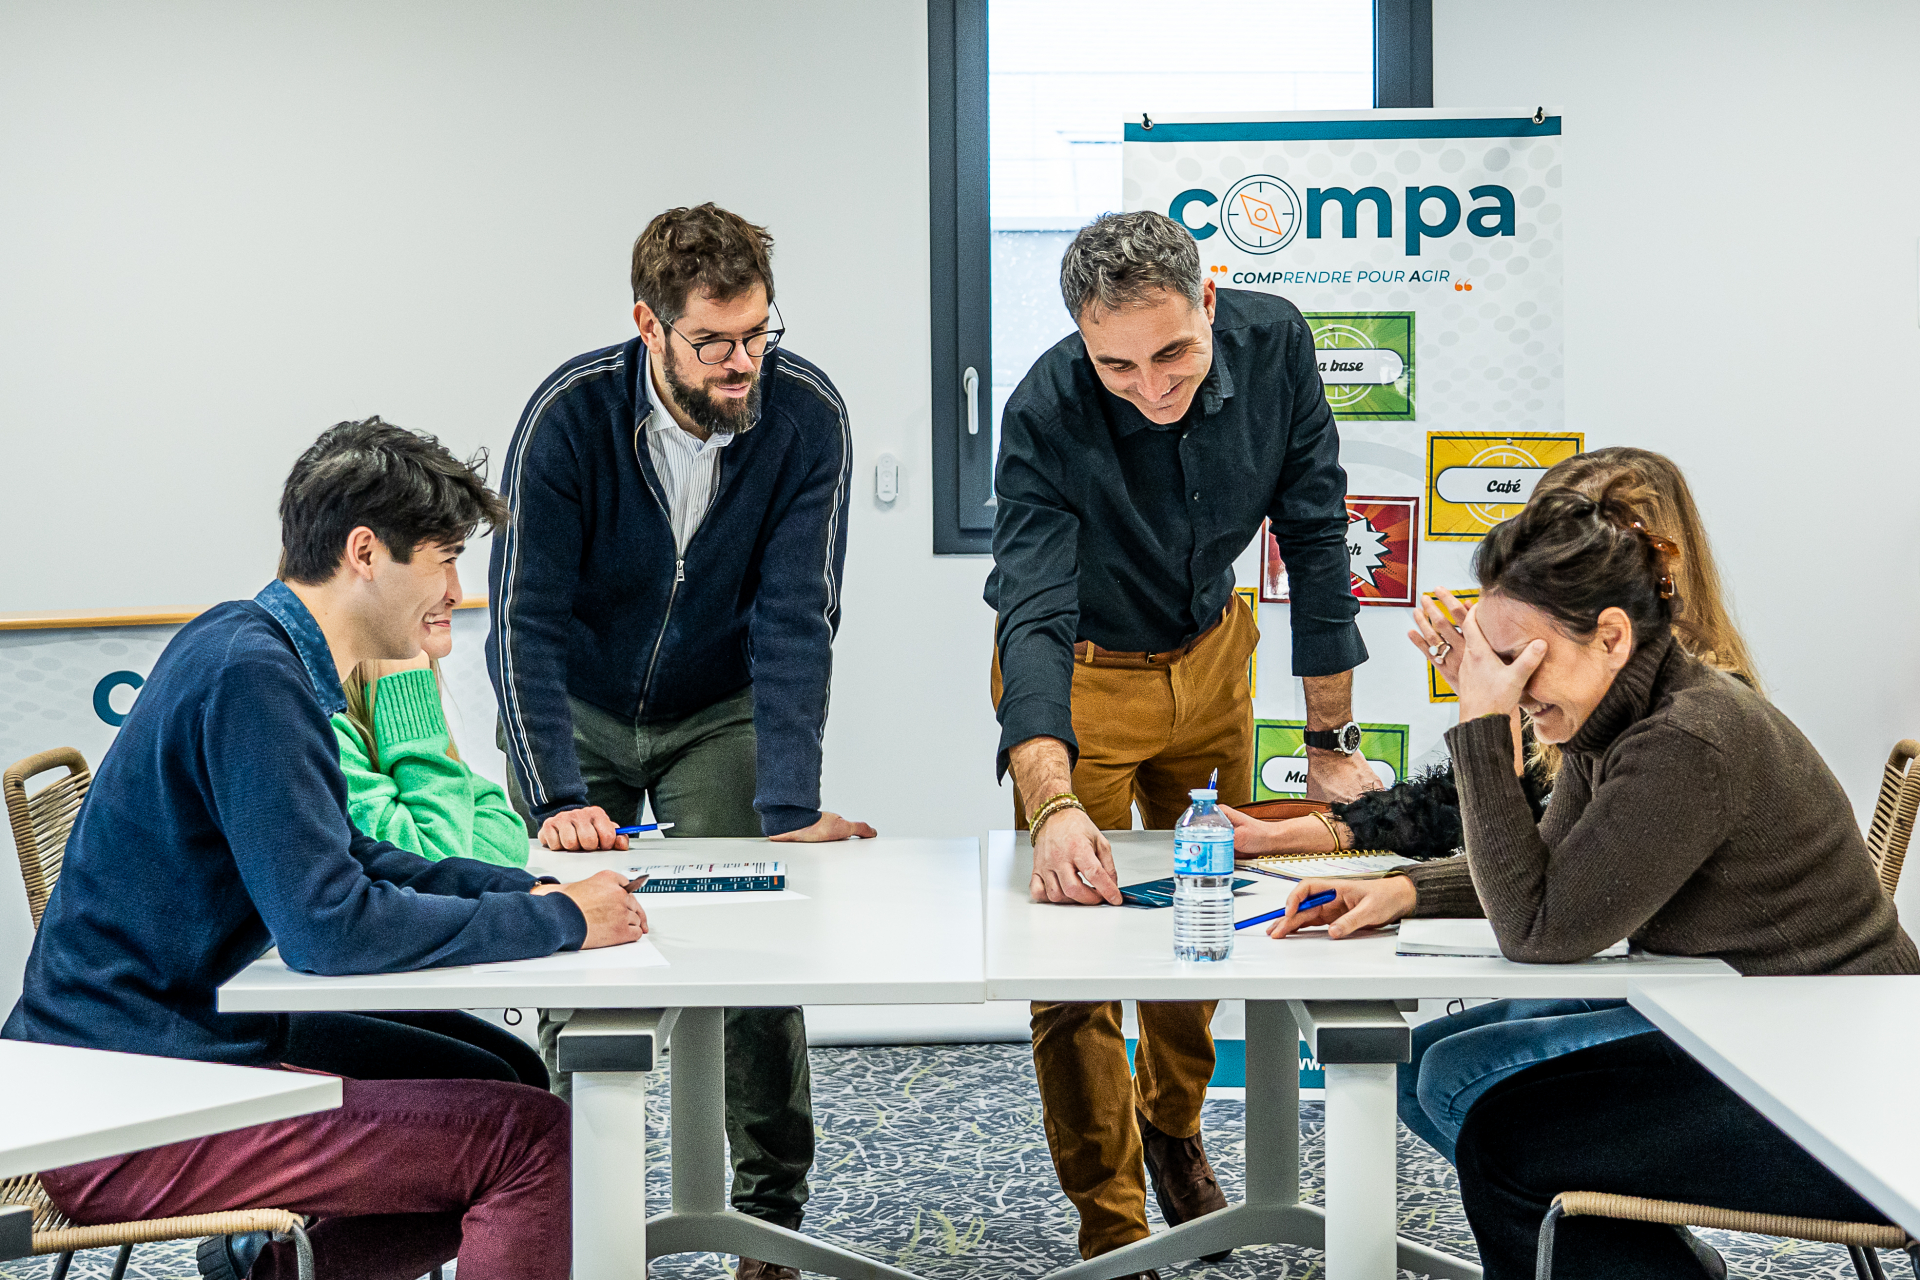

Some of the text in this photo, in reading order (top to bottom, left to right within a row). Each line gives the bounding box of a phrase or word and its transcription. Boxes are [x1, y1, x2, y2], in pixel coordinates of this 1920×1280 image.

[1232, 269, 1451, 285] COMPRENDRE POUR AGIR
[1318, 359, 1364, 372] a base
[1486, 478, 1522, 494] Café
